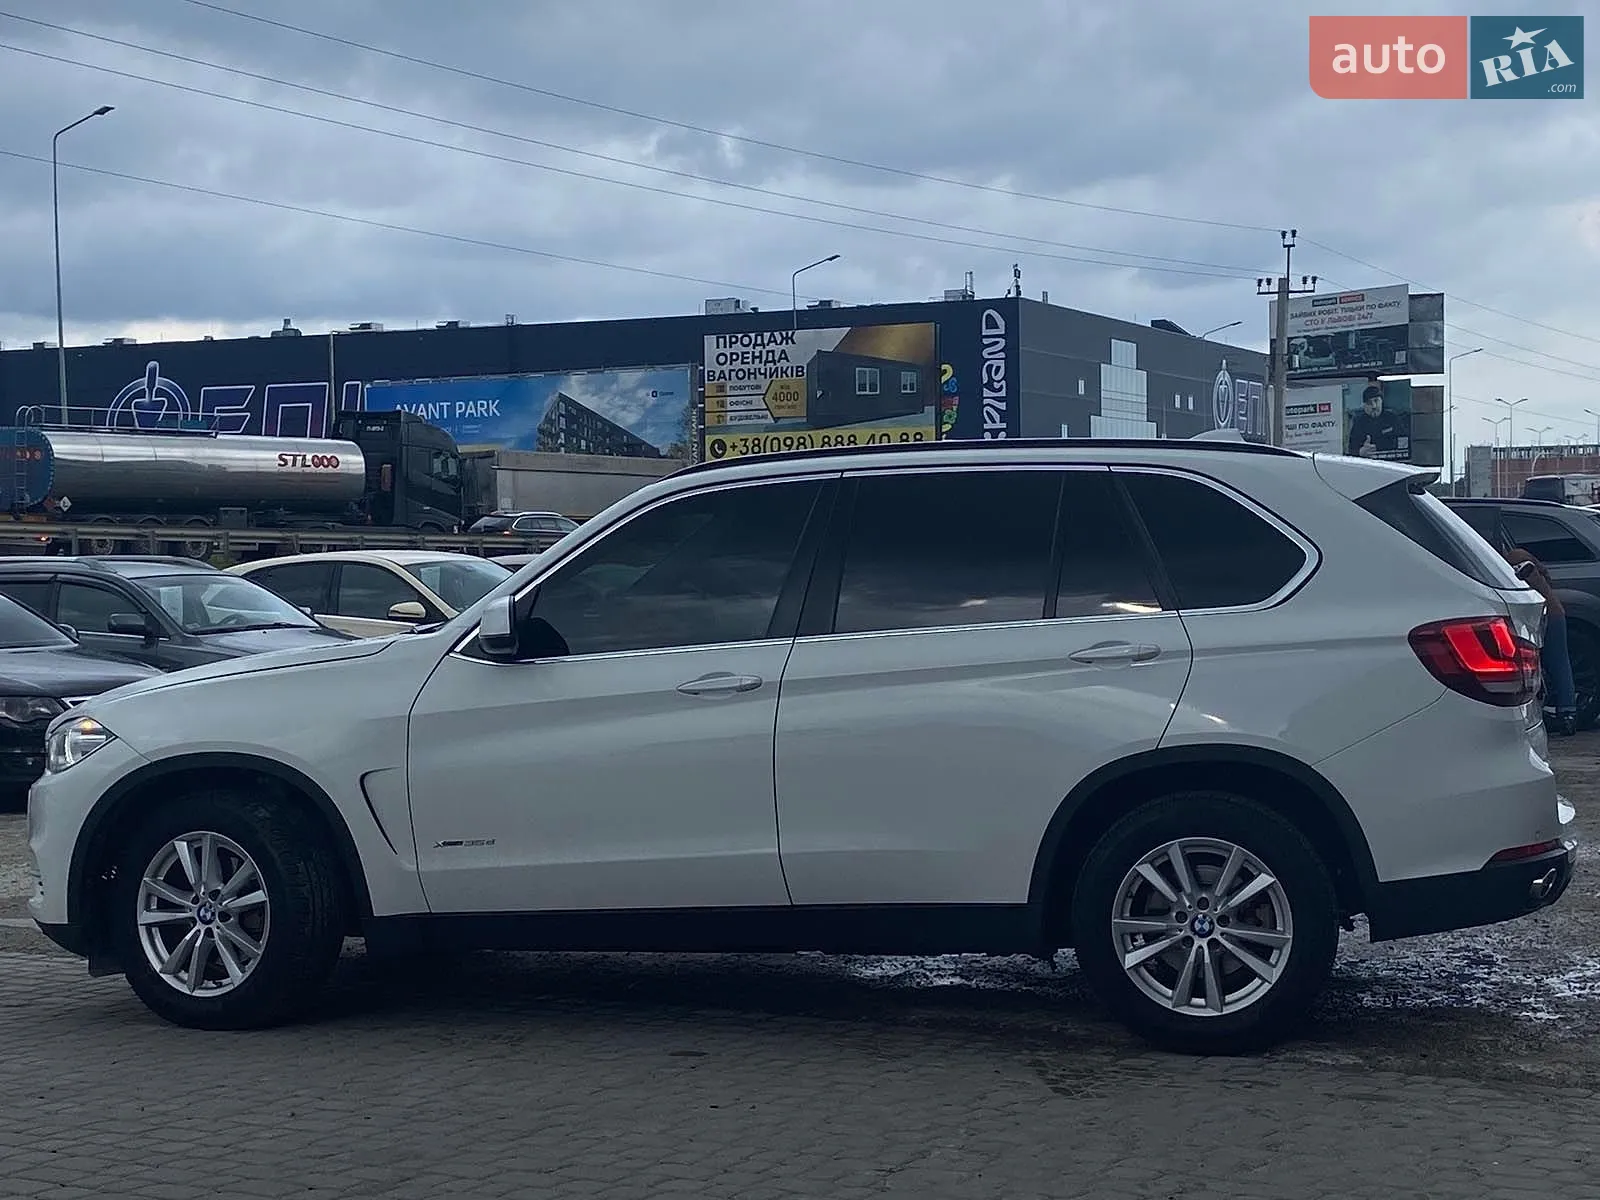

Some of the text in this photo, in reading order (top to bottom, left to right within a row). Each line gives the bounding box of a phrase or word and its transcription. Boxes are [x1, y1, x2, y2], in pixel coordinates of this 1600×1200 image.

[716, 331, 797, 349] ПРОДАЖ
[716, 349, 790, 367] ОРЕНДА
[707, 365, 805, 381] ВАГОНЧИКІВ
[771, 391, 799, 402] 4000
[455, 400, 500, 418] PARK
